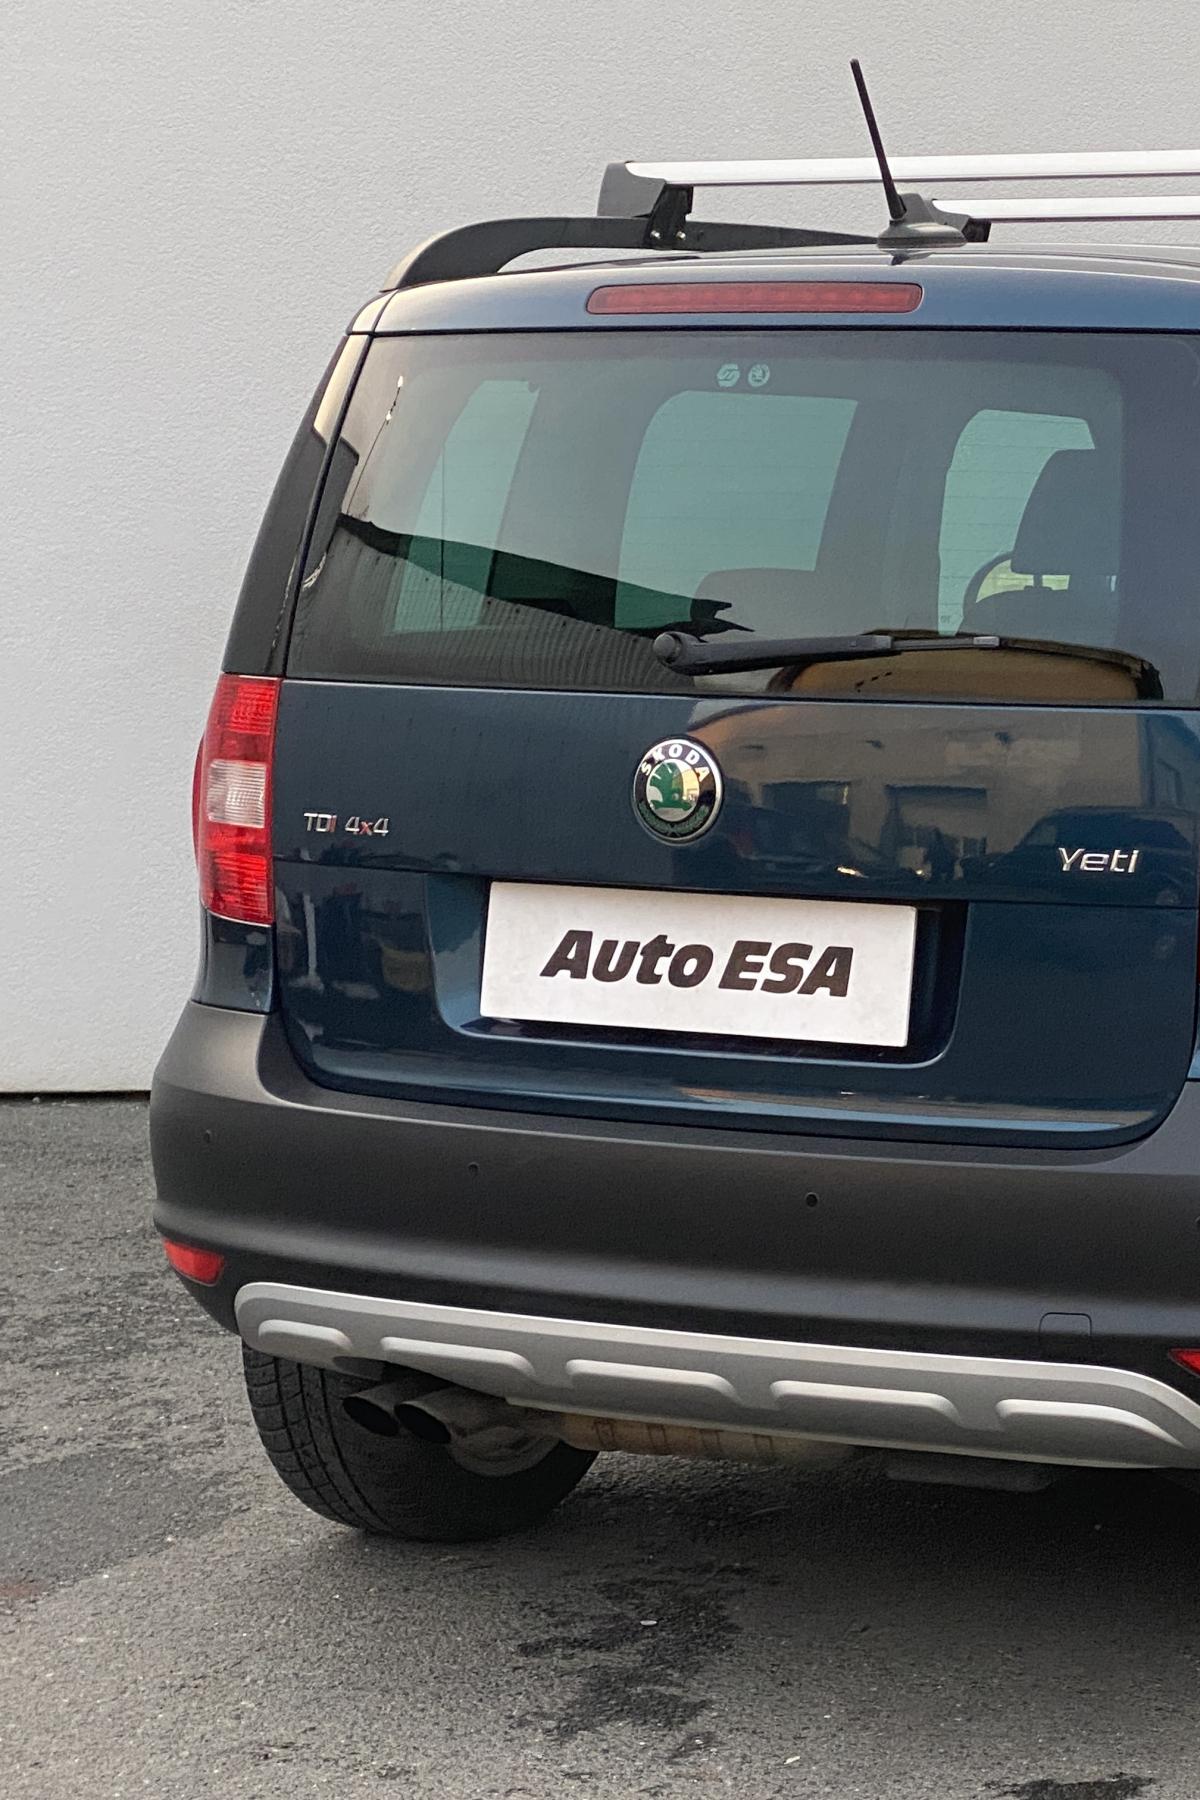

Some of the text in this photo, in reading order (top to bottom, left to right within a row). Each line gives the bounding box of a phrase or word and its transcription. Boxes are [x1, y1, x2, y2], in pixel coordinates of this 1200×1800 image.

[344, 816, 389, 837] 4x4
[1058, 847, 1140, 873] Yeti
[540, 929, 854, 998] Auto ESA
